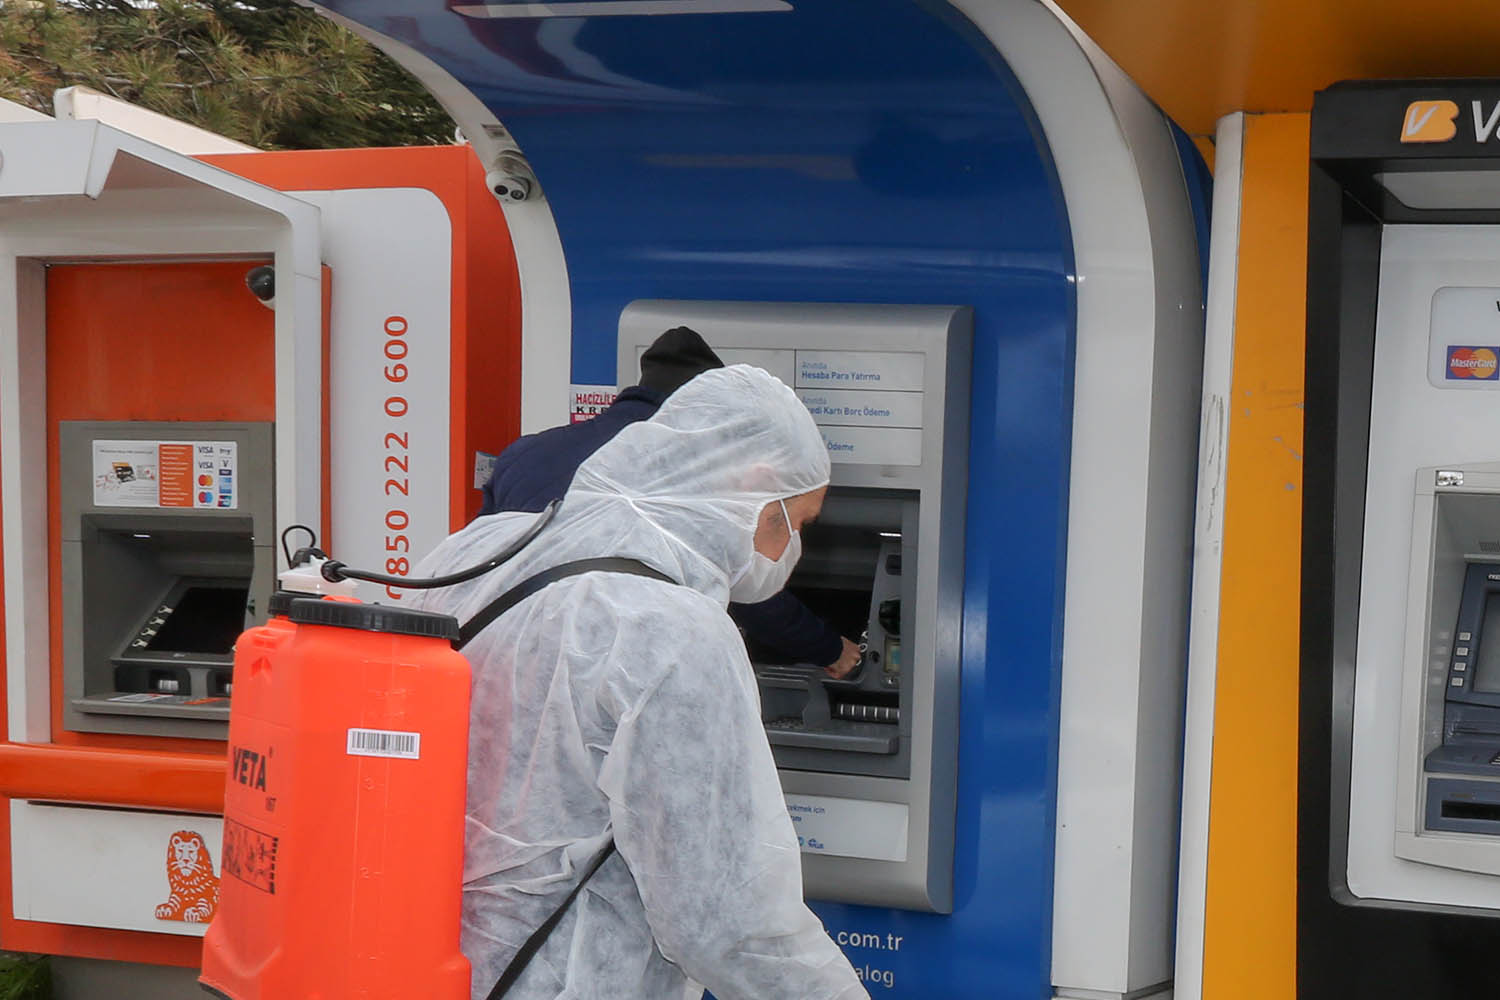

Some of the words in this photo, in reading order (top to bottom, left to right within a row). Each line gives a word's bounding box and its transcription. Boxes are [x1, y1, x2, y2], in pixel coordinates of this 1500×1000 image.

[383, 315, 409, 383] 600
[1450, 358, 1497, 369] MasterCard
[801, 370, 830, 380] Hesaba
[831, 371, 850, 381] Para
[851, 372, 881, 381] Yatırma
[384, 395, 409, 418] 0
[384, 431, 409, 496] 222
